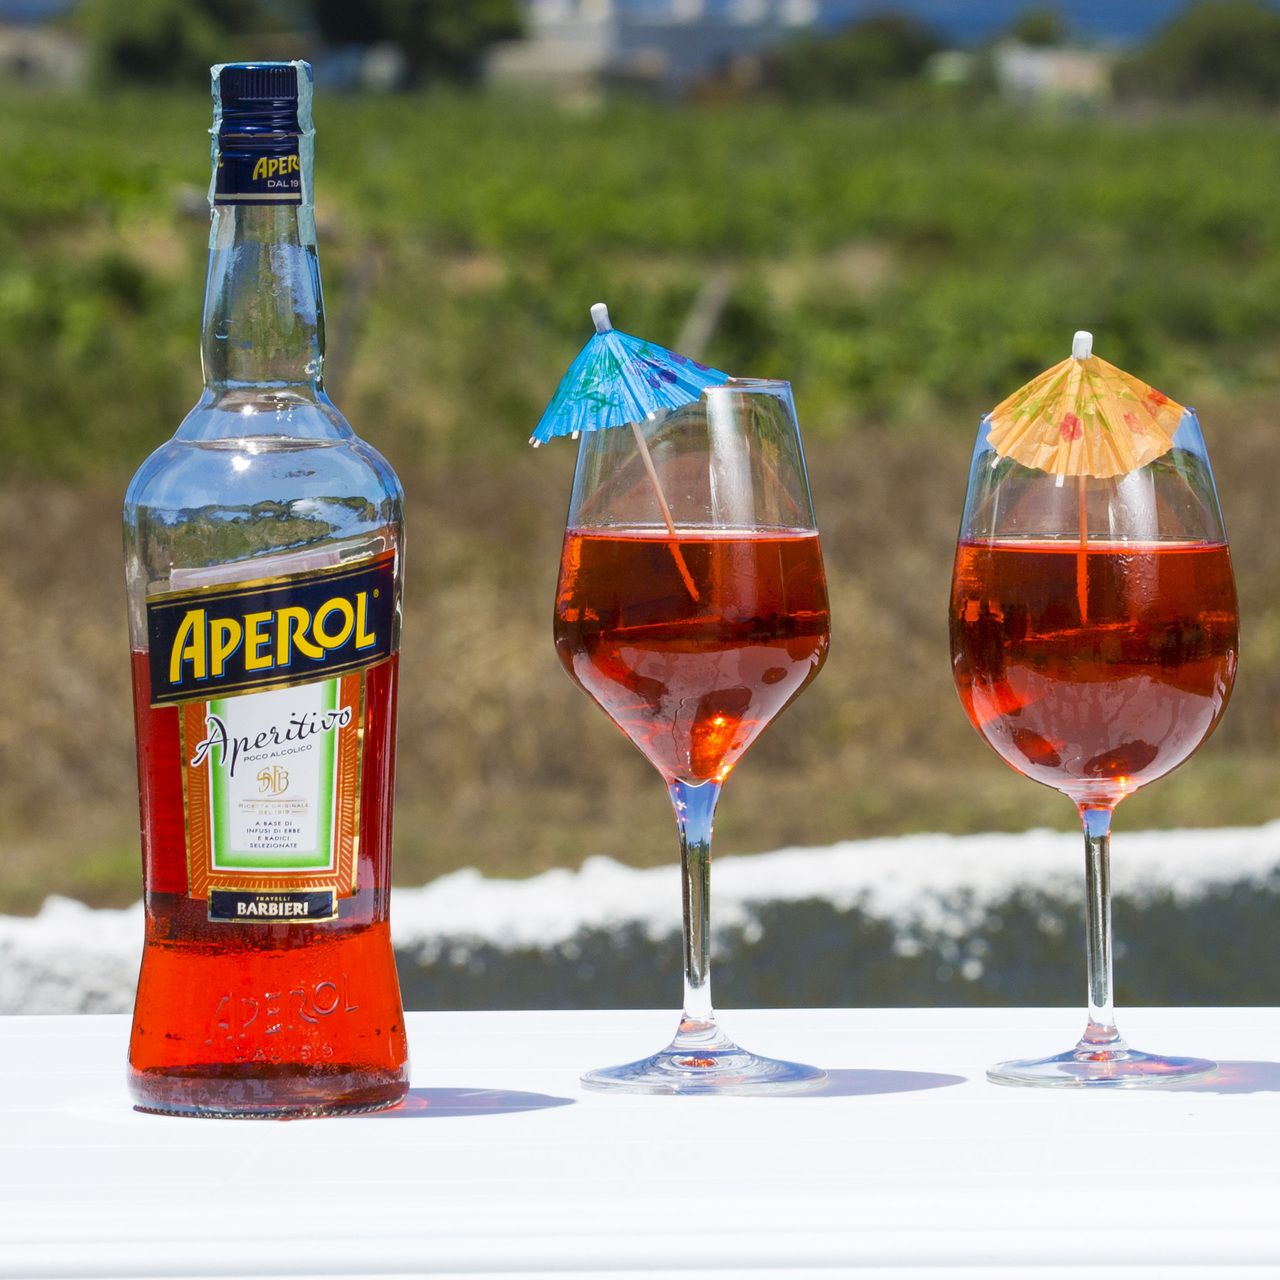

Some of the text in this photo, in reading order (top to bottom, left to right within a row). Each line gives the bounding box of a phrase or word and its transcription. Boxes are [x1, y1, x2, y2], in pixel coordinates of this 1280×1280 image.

[252, 154, 300, 180] APER
[267, 180, 300, 188] DAL 19
[170, 591, 377, 684] APEROL
[192, 708, 351, 778] Aperitivo
[243, 744, 313, 763] POCO ALCOLICO
[237, 902, 308, 915] BARBIERI
[204, 973, 359, 1044] APEROL
